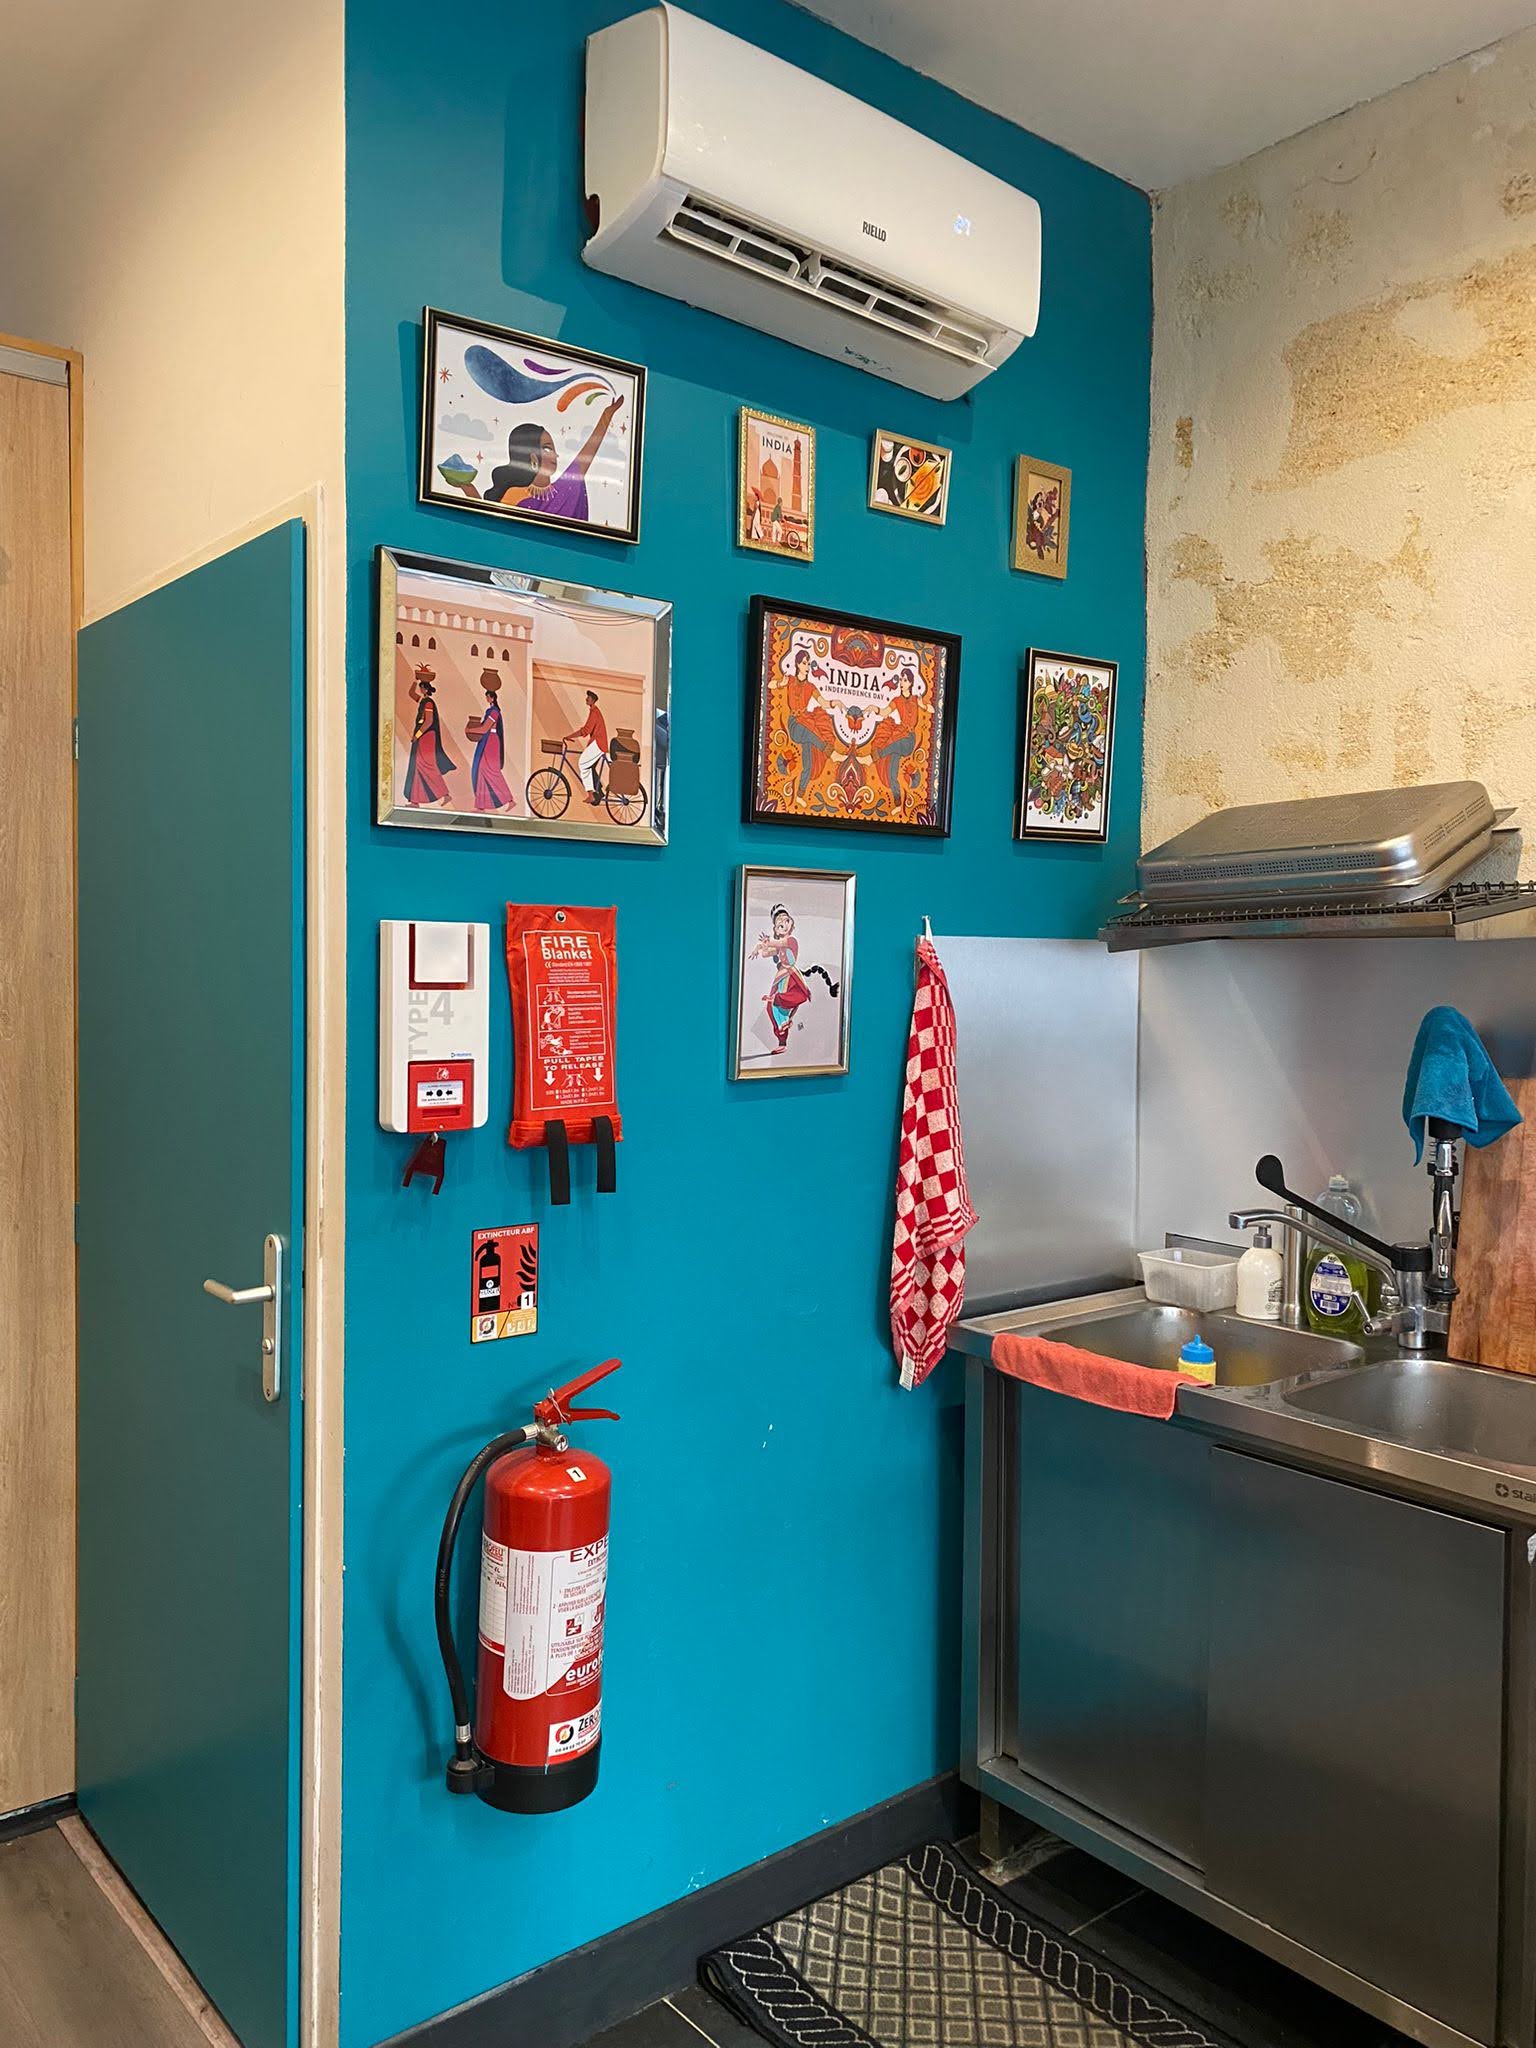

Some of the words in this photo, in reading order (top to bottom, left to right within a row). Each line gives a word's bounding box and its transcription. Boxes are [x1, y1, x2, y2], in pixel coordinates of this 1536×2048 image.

[862, 220, 887, 242] RIELLO
[762, 435, 793, 455] INDIA
[829, 668, 880, 692] INDIA
[825, 685, 872, 699] INDEPENDENCE
[872, 692, 885, 701] DAY
[540, 935, 590, 948] FIRE
[541, 947, 593, 960] Blanket
[430, 992, 455, 1025] 4
[408, 992, 429, 1060] TYPE
[543, 1057, 571, 1065] PULL
[575, 1055, 605, 1063] TAPES
[560, 1061, 605, 1070] RELEASE
[477, 1228, 521, 1240] EXTINCTEUR
[524, 1293, 530, 1306] 1
[572, 1469, 582, 1478] 1
